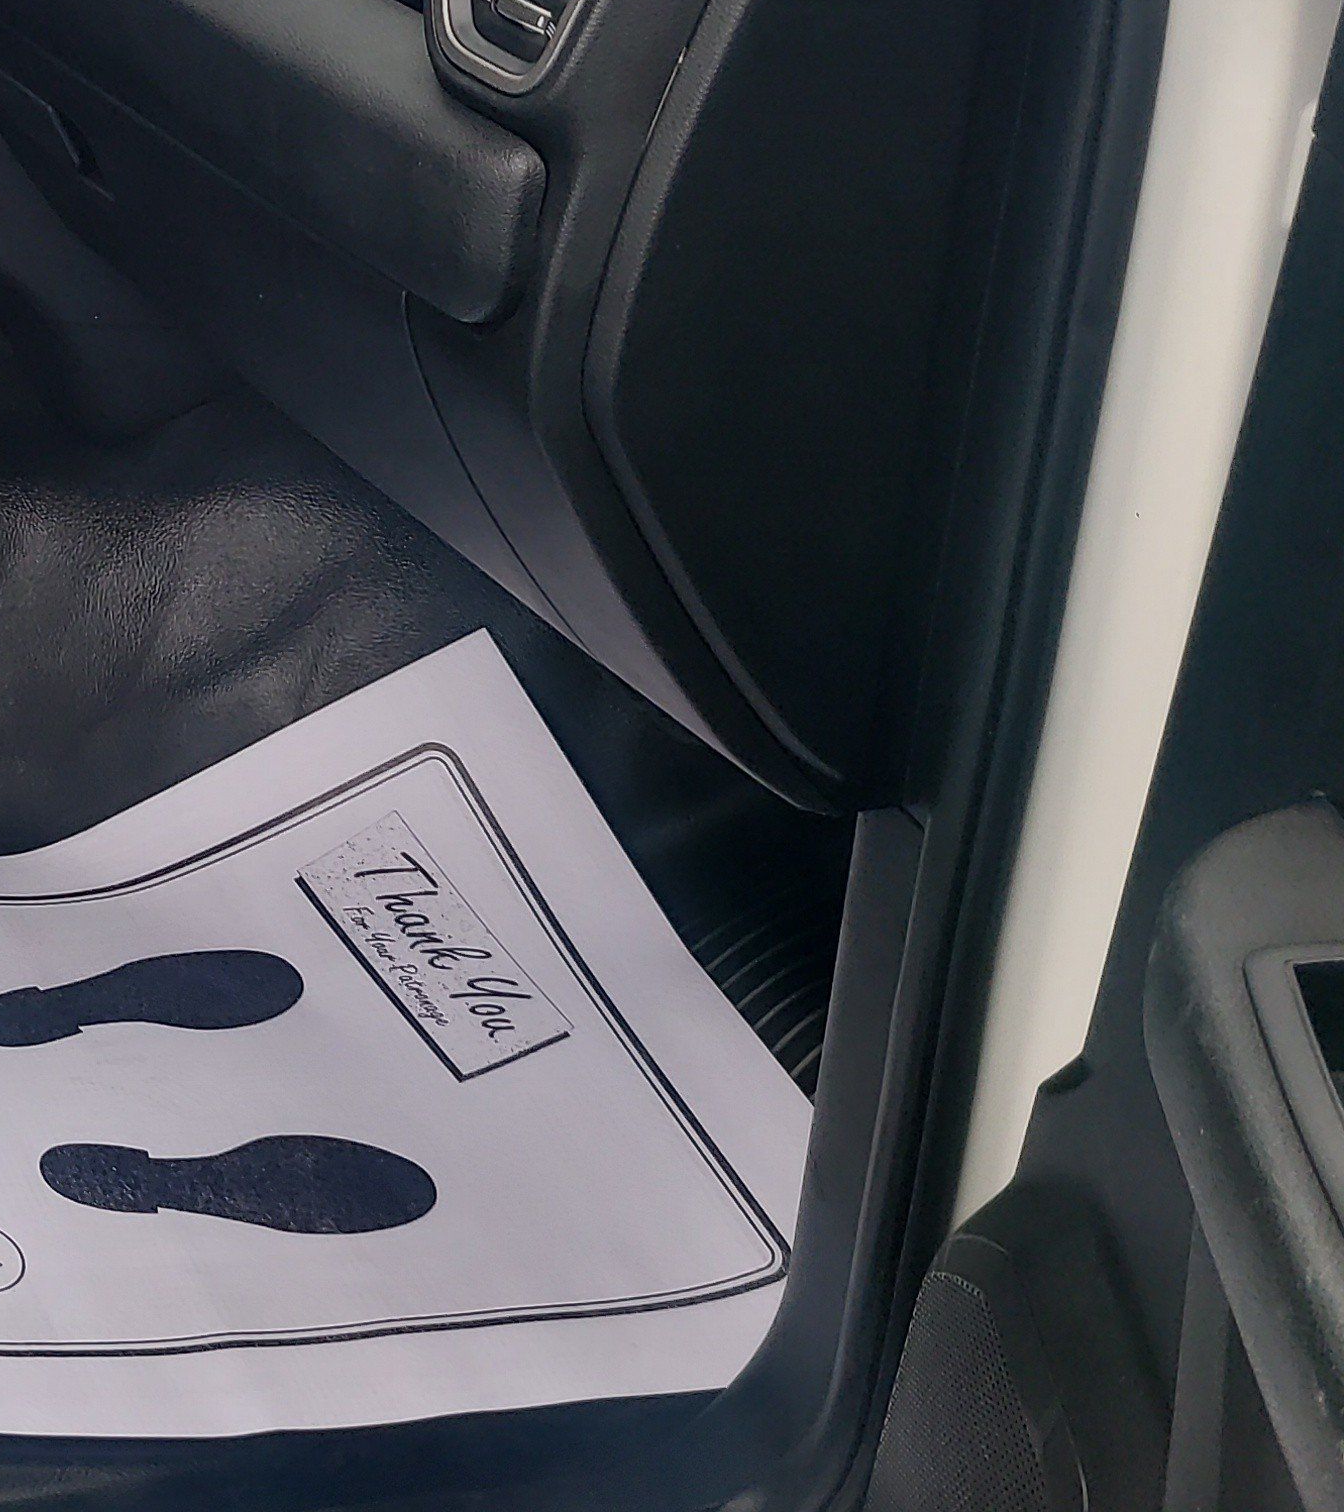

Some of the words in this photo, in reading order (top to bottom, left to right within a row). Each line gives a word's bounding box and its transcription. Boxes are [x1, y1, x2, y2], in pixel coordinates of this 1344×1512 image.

[342, 906, 375, 931] For
[364, 932, 397, 963] Your
[392, 963, 450, 1027] Patronage
[353, 851, 493, 970] Thank
[448, 977, 533, 1039] You
